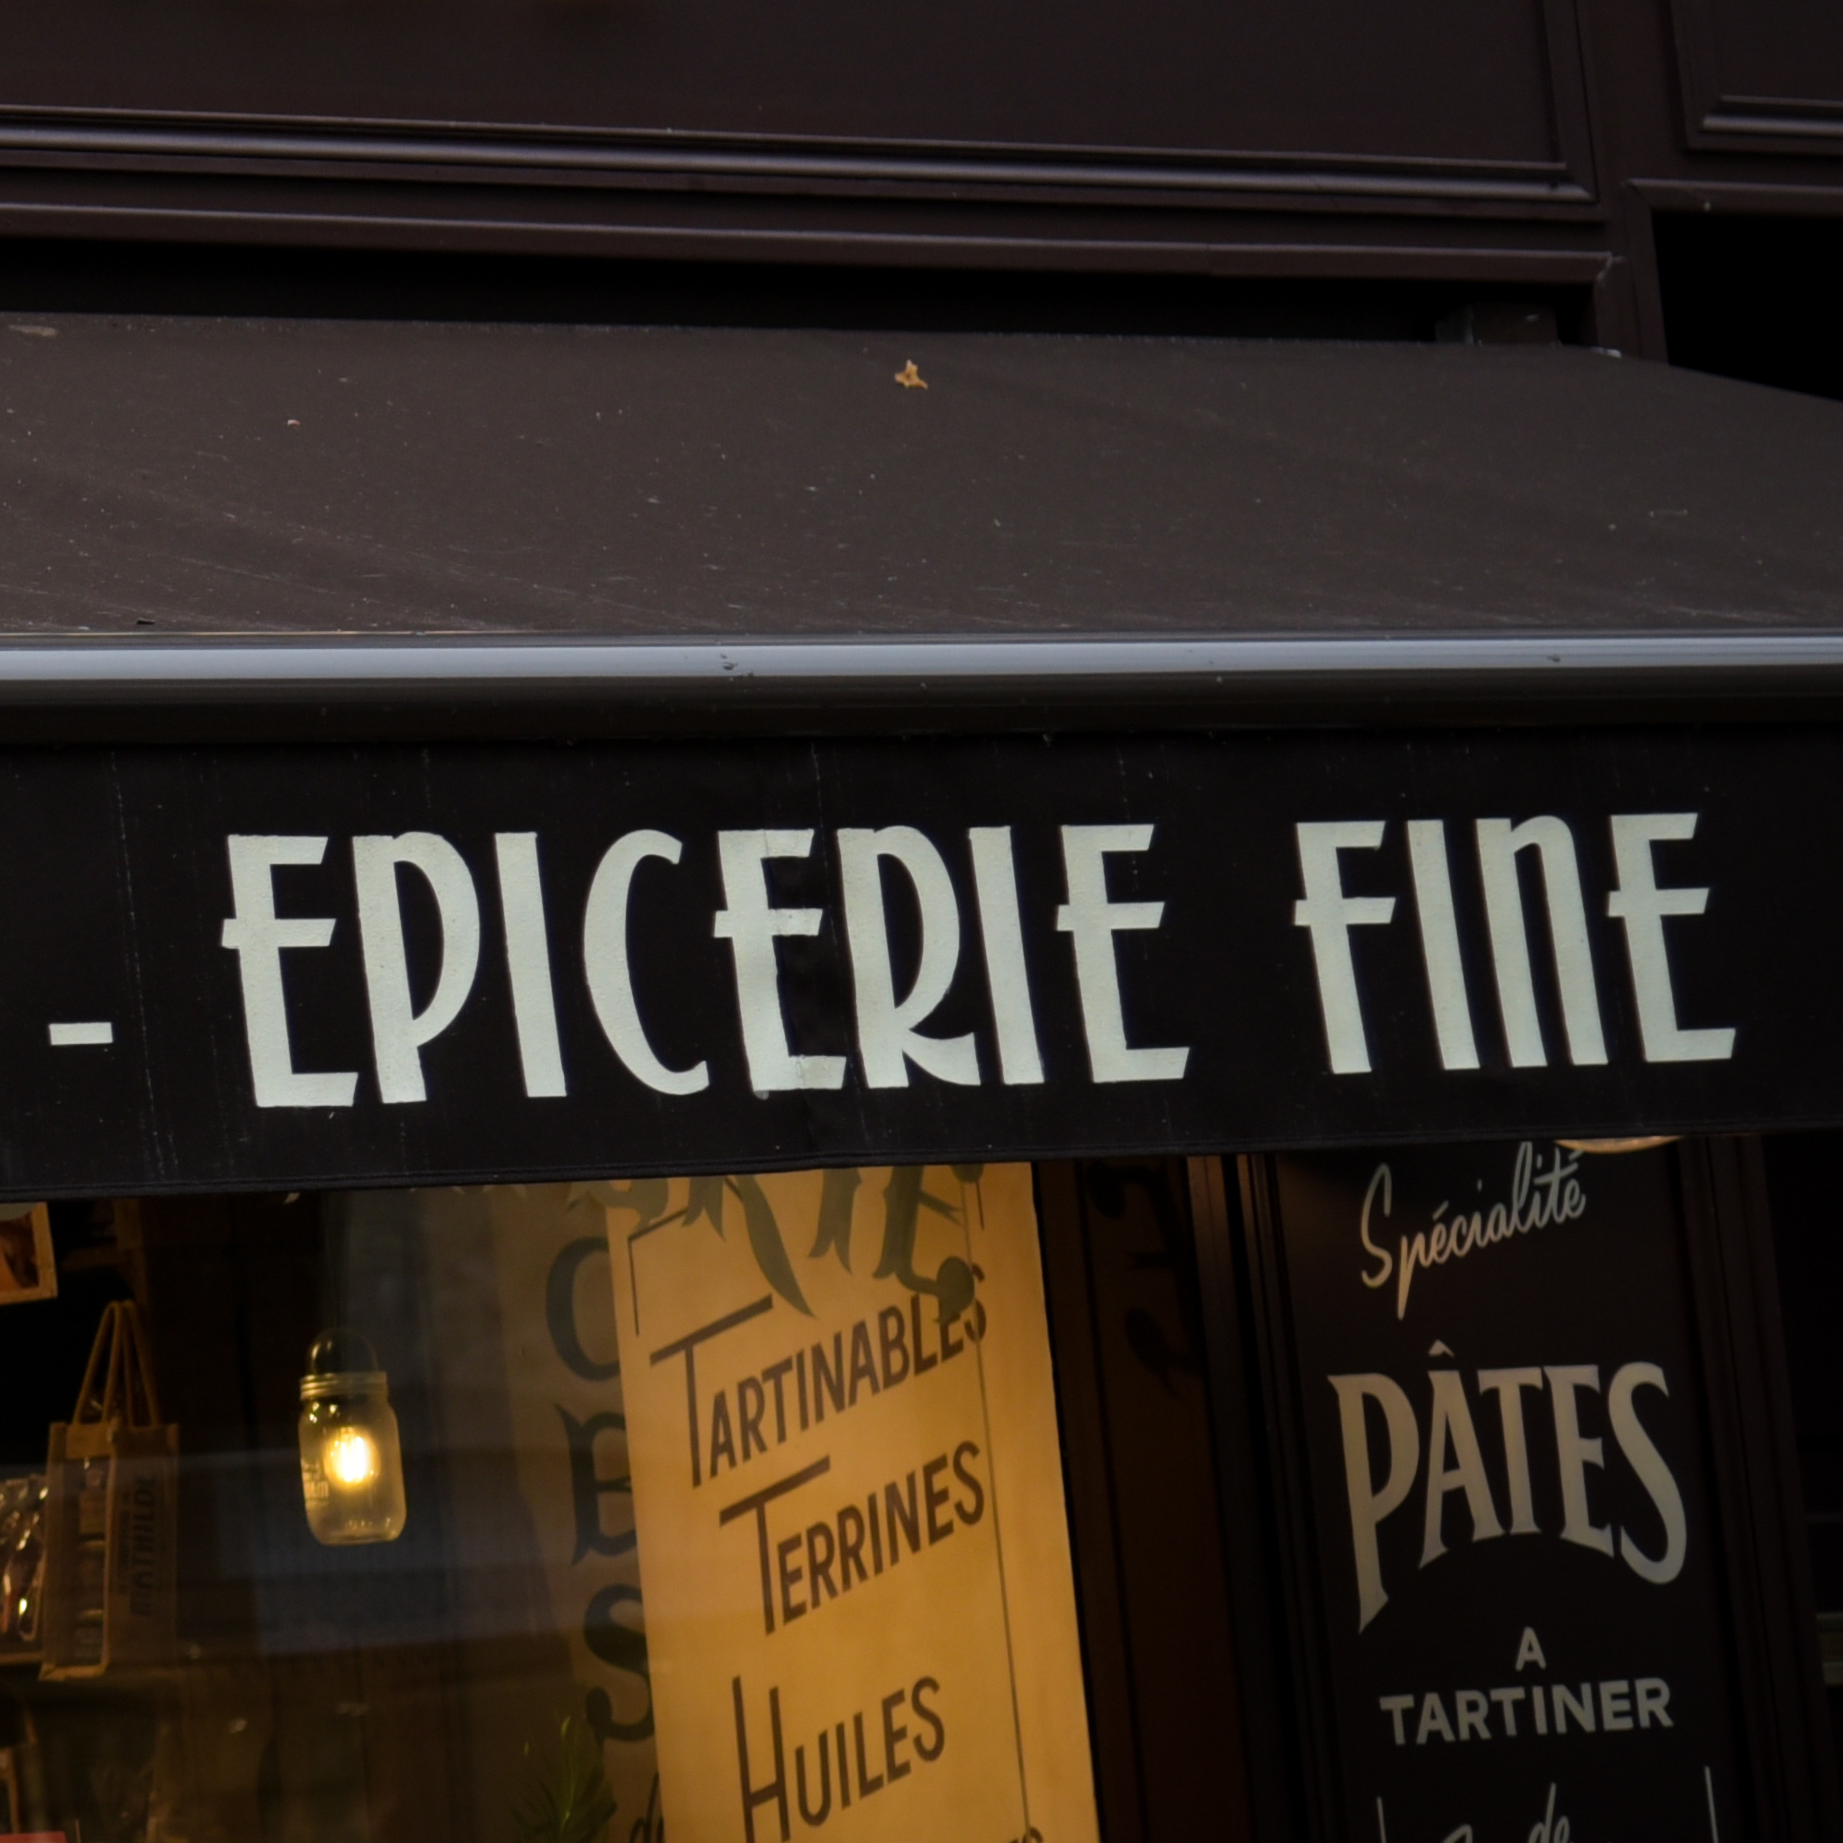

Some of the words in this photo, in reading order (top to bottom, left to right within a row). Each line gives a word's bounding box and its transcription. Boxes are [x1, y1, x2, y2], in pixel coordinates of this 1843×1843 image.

[222, 825, 1189, 1107] EPICERIE
[1295, 814, 1735, 1074] FINE
[1360, 1141, 1587, 1321] Spécialité
[719, 1441, 986, 1636] TERRINES
[1327, 1339, 1688, 1634] PÂTES
[1379, 1677, 1674, 1745] TARTINER
[1515, 1627, 1547, 1671] A
[732, 1675, 946, 1843] HUILES
